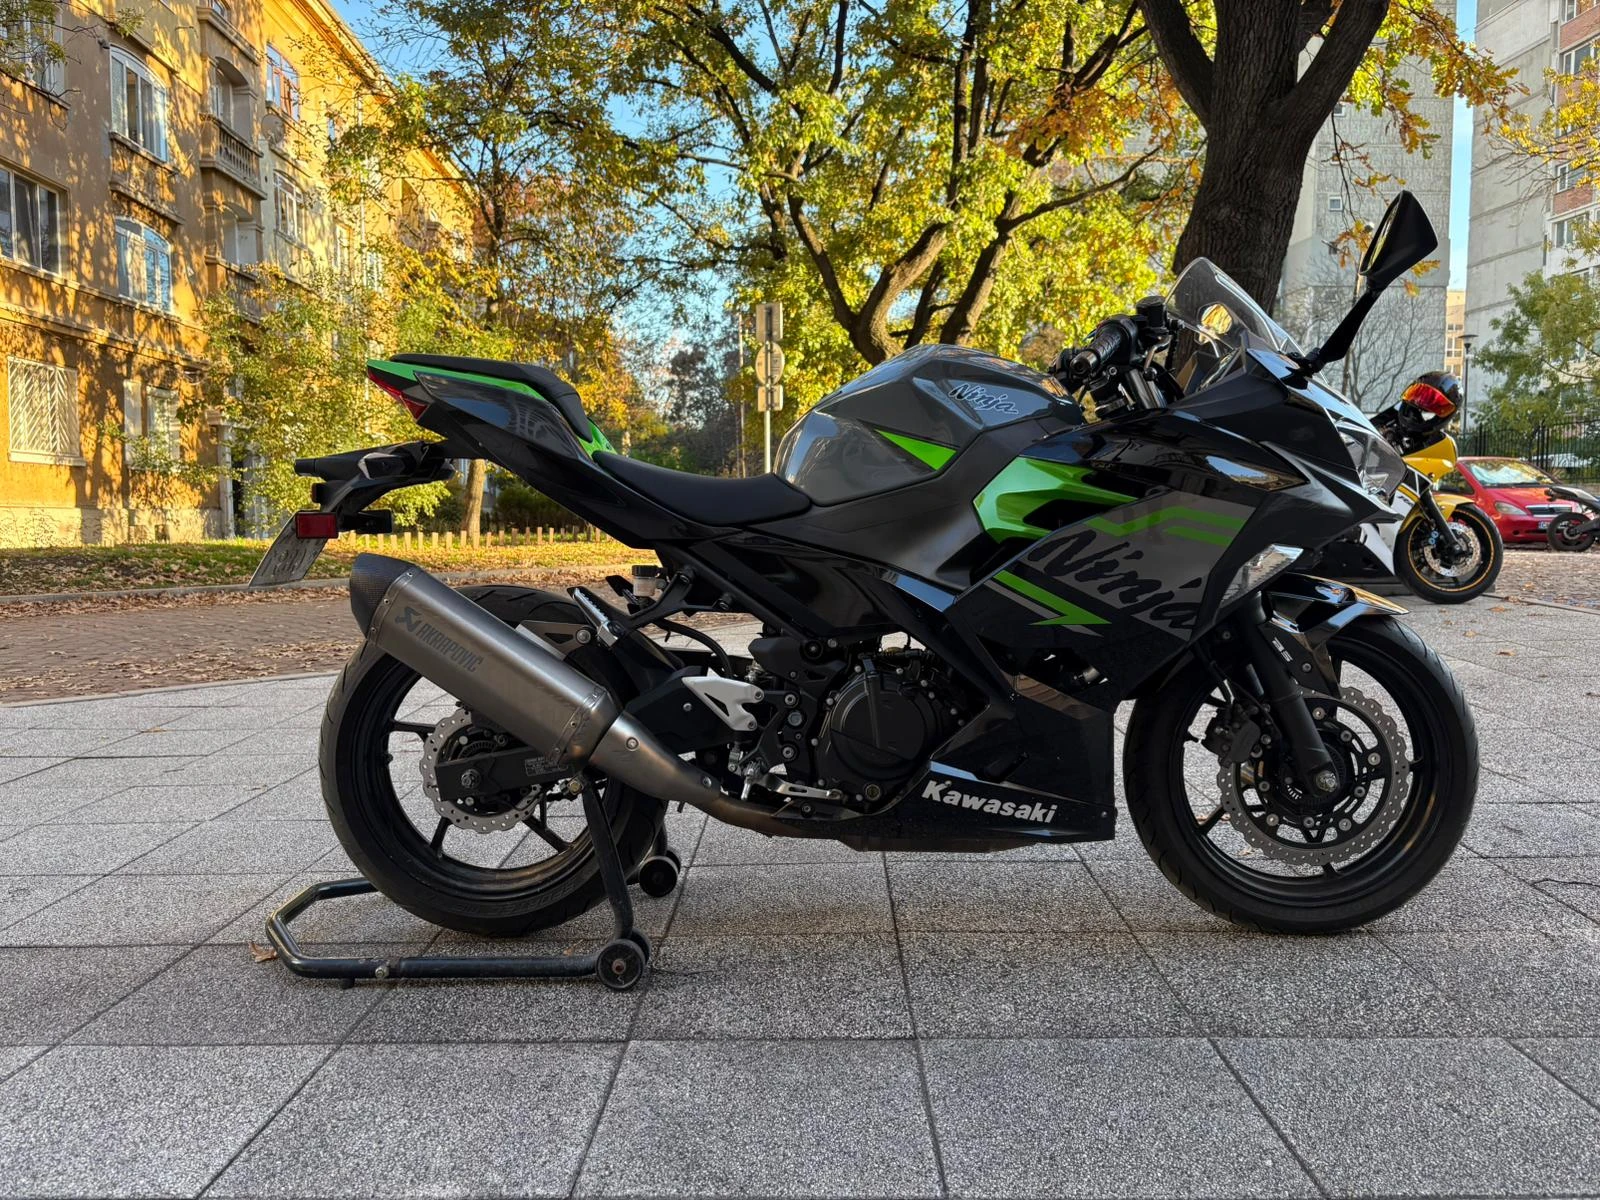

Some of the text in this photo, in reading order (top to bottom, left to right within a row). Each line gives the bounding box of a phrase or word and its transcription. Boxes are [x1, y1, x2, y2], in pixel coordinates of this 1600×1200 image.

[948, 383, 1019, 415] Ninja
[1027, 529, 1203, 631] Ninja
[921, 780, 1058, 823] Kawasaki
